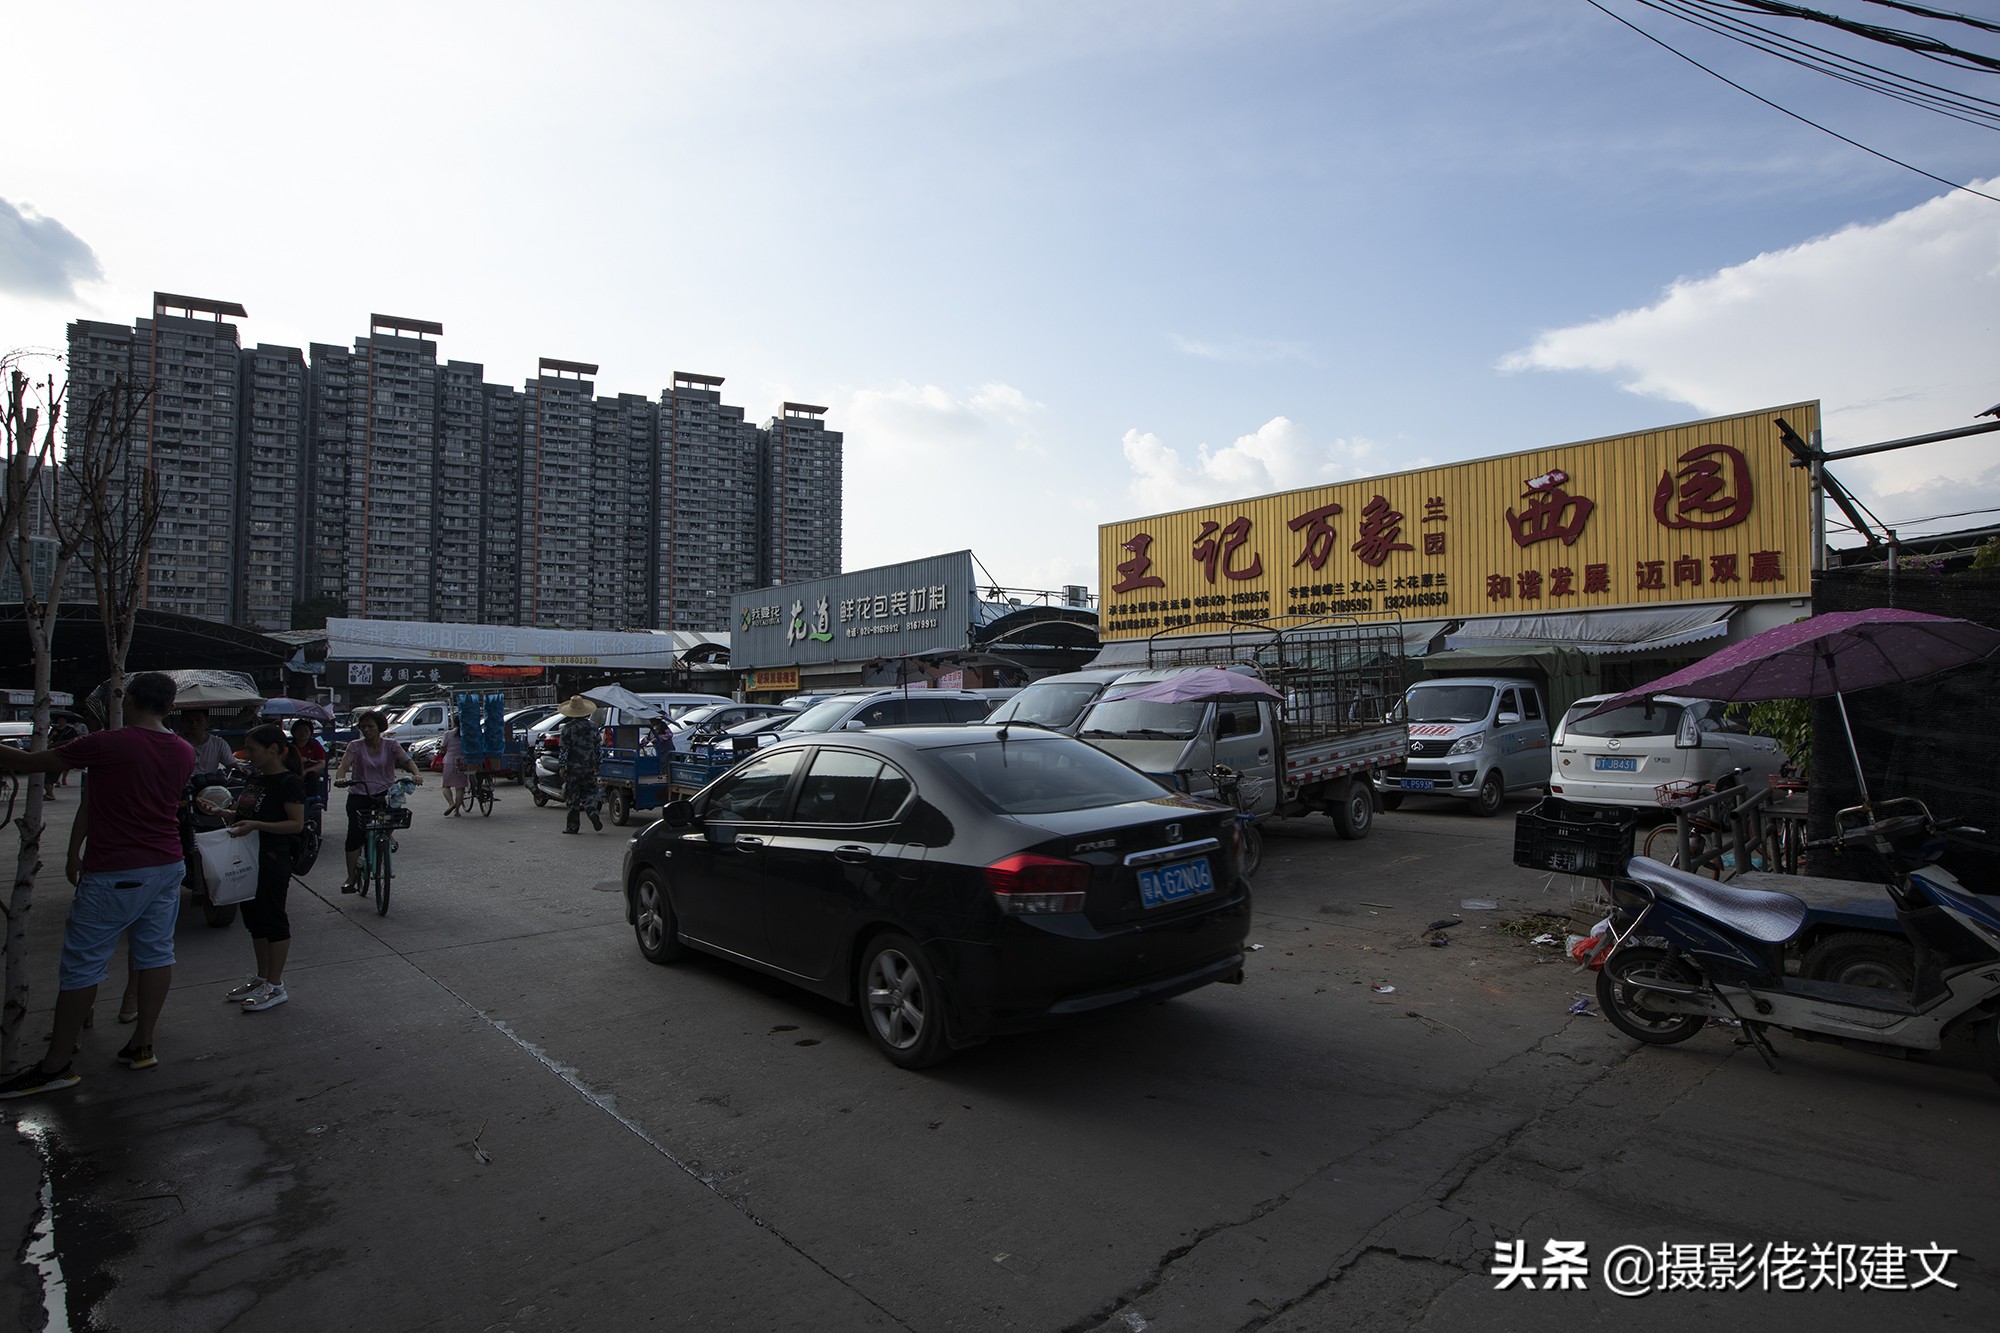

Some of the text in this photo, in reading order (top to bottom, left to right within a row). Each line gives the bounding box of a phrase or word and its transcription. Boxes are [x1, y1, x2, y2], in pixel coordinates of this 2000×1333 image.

[1422, 497, 1448, 556] 兰园
[1288, 573, 1448, 598] 专营蝴蝶兰 文心兰 大花蕙兰
[1487, 550, 1784, 602] 和谐发展 迈向双赢
[787, 584, 947, 647] 花道 鲜花包装材料
[906, 619, 938, 631] 81679913
[1108, 597, 1191, 616] 承接全国物流运输
